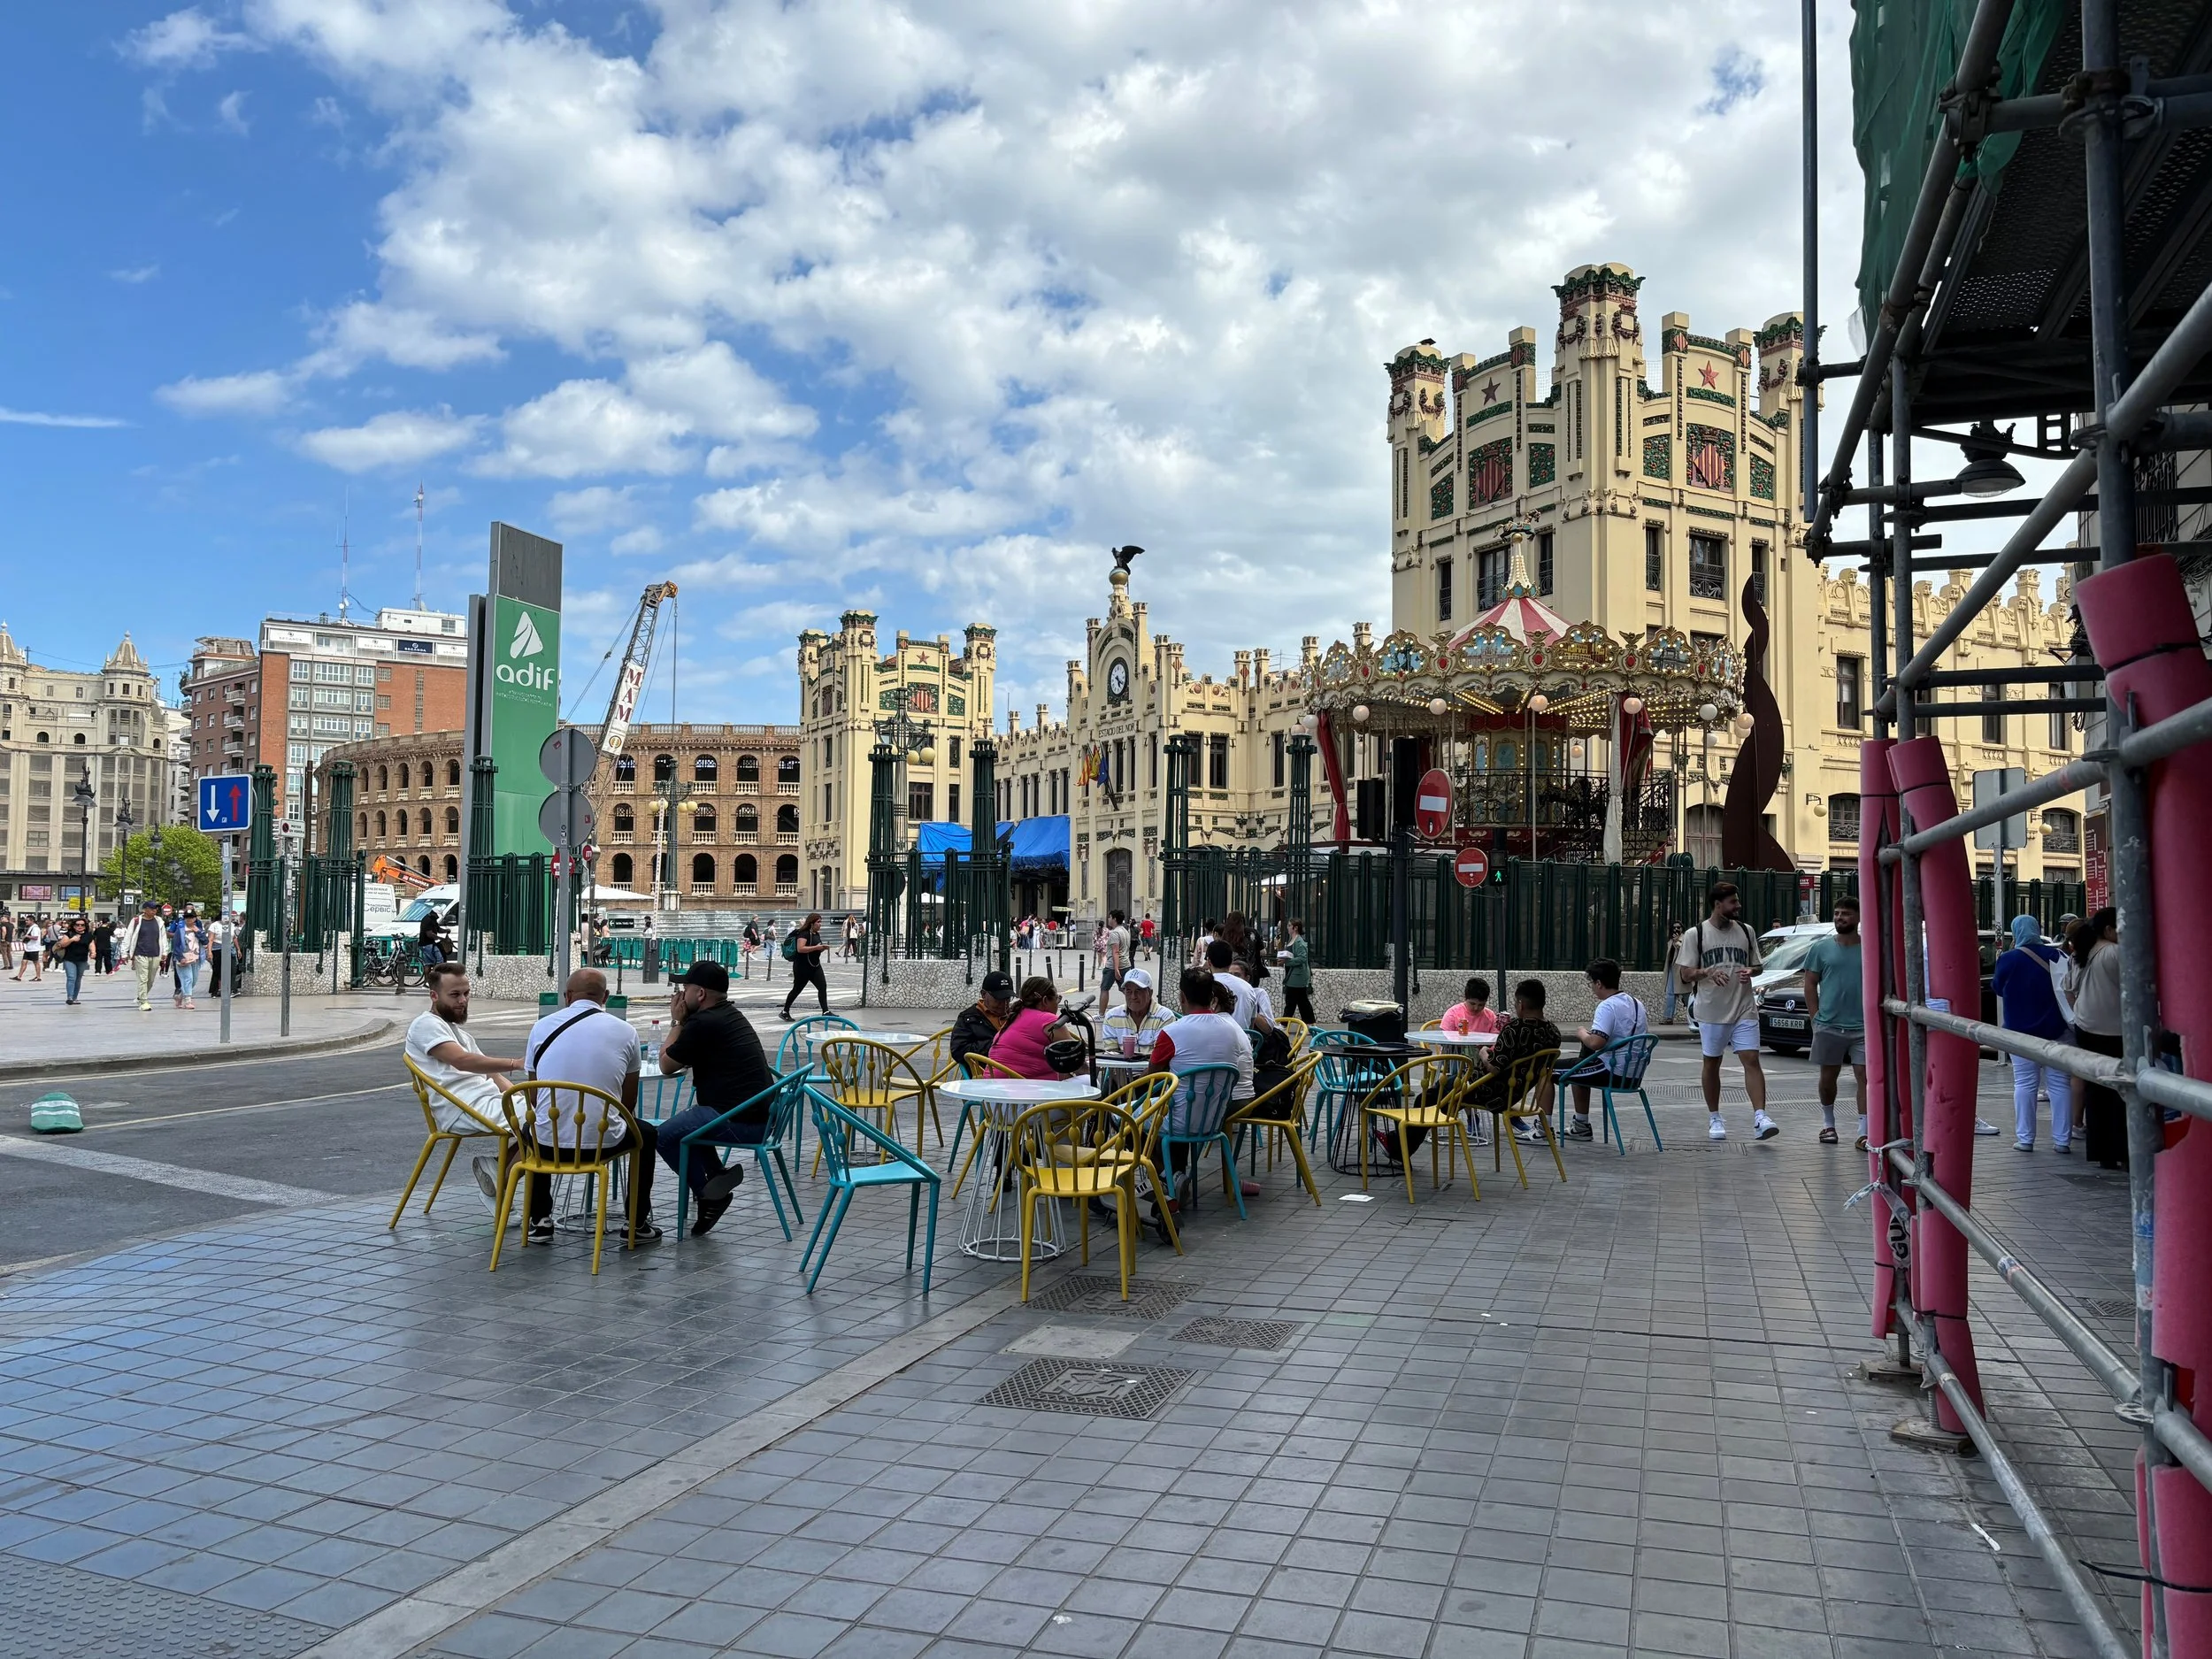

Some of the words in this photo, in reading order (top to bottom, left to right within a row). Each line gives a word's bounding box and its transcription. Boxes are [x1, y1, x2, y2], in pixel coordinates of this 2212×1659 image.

[496, 662, 556, 691] adif
[1701, 947, 1724, 969] NEW
[1773, 1018, 1789, 1027] 5656
